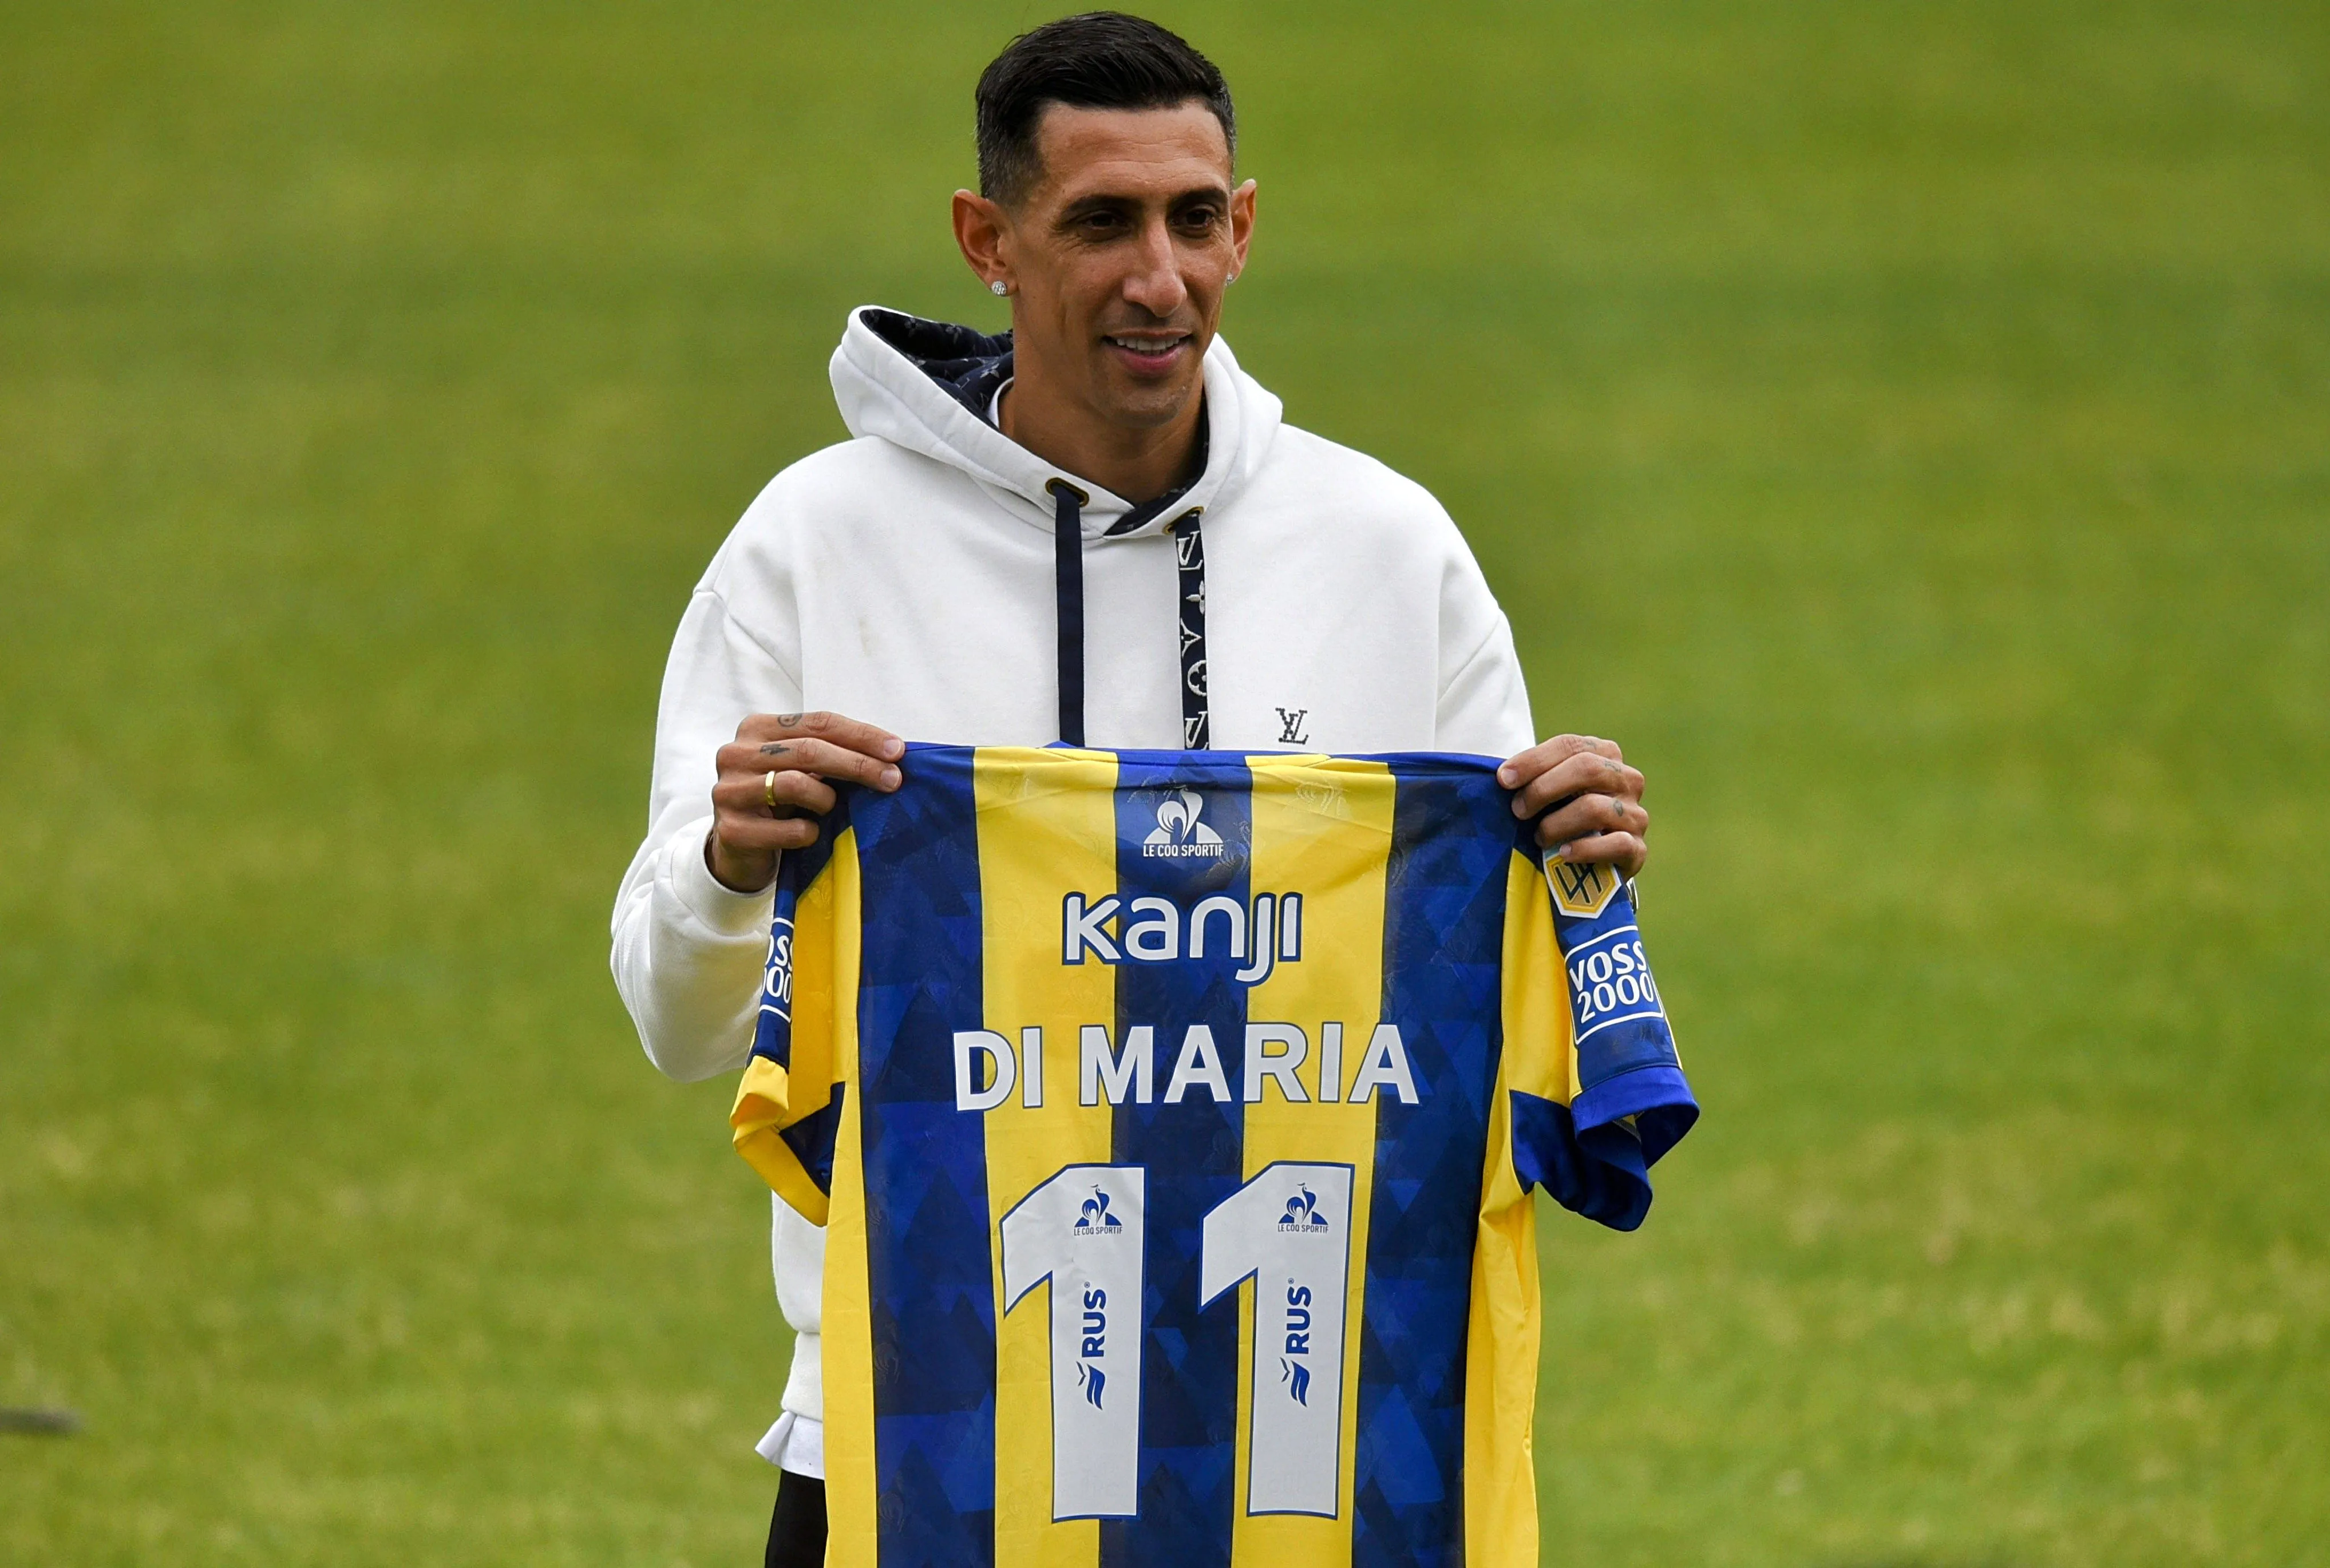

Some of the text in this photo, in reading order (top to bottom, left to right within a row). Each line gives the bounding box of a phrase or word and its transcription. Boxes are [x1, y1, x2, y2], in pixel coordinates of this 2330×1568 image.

[1143, 844, 1224, 857] LE COQ SPORTIF
[1569, 940, 1648, 992] VOSS
[1577, 972, 1654, 1024] 2000
[953, 1021, 1420, 1111] DI MARIA
[1074, 1226, 1123, 1236] LE COQ SPORTIF
[1302, 1225, 1329, 1234] SPORTIF
[999, 1161, 1355, 1524] 11
